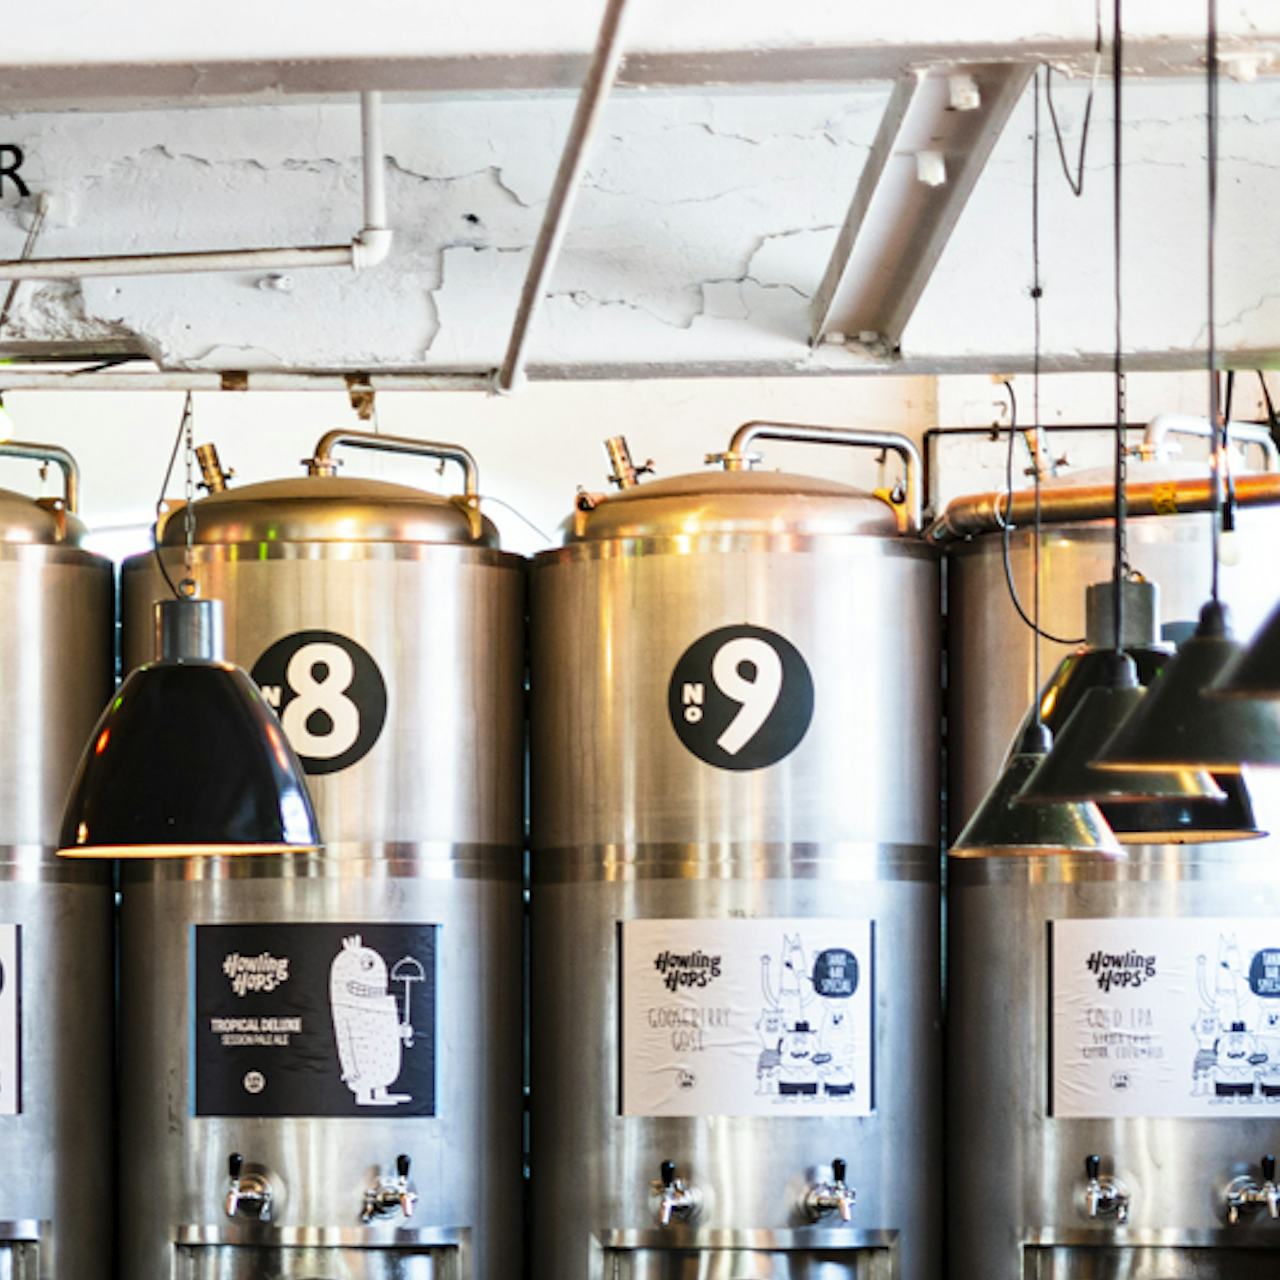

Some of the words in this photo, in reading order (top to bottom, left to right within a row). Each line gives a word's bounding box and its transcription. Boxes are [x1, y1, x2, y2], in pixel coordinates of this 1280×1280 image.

[281, 641, 360, 759] 8
[711, 636, 784, 756] 9
[223, 952, 289, 981] Howling
[654, 949, 722, 977] Howling
[1086, 949, 1157, 977] Howling
